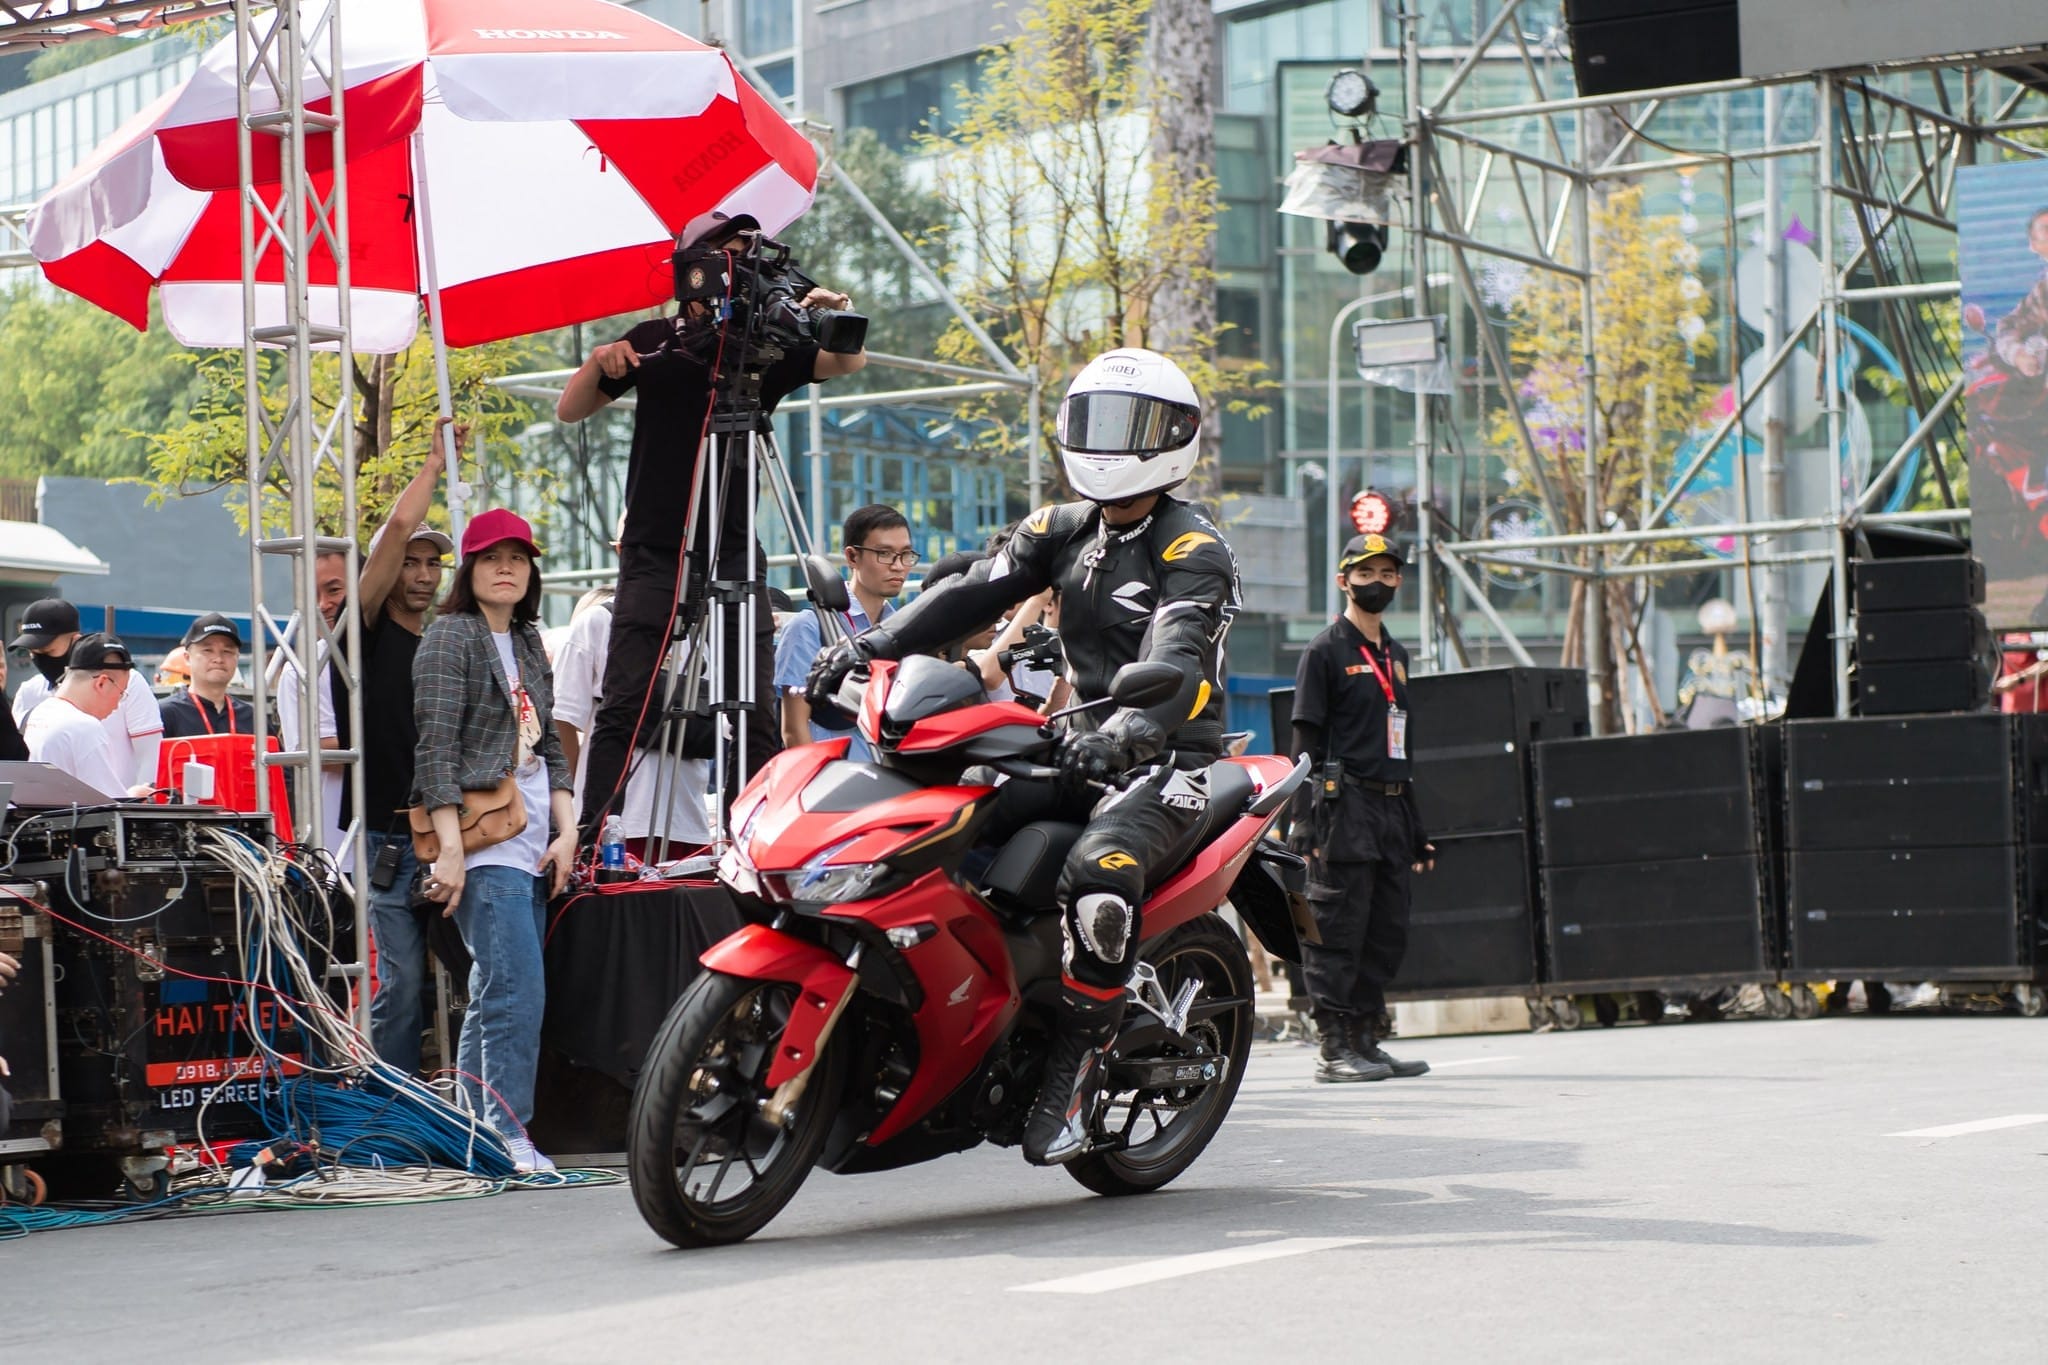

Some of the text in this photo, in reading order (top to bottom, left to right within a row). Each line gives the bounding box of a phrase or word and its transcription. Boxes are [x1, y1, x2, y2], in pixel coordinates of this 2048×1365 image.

[472, 29, 629, 39] HONDA
[1103, 364, 1136, 376] HOEI
[1118, 515, 1153, 543] TAICHI
[1074, 919, 1093, 952] TAICHI
[155, 1003, 295, 1037] HAI TREU
[160, 1089, 195, 1109] LED
